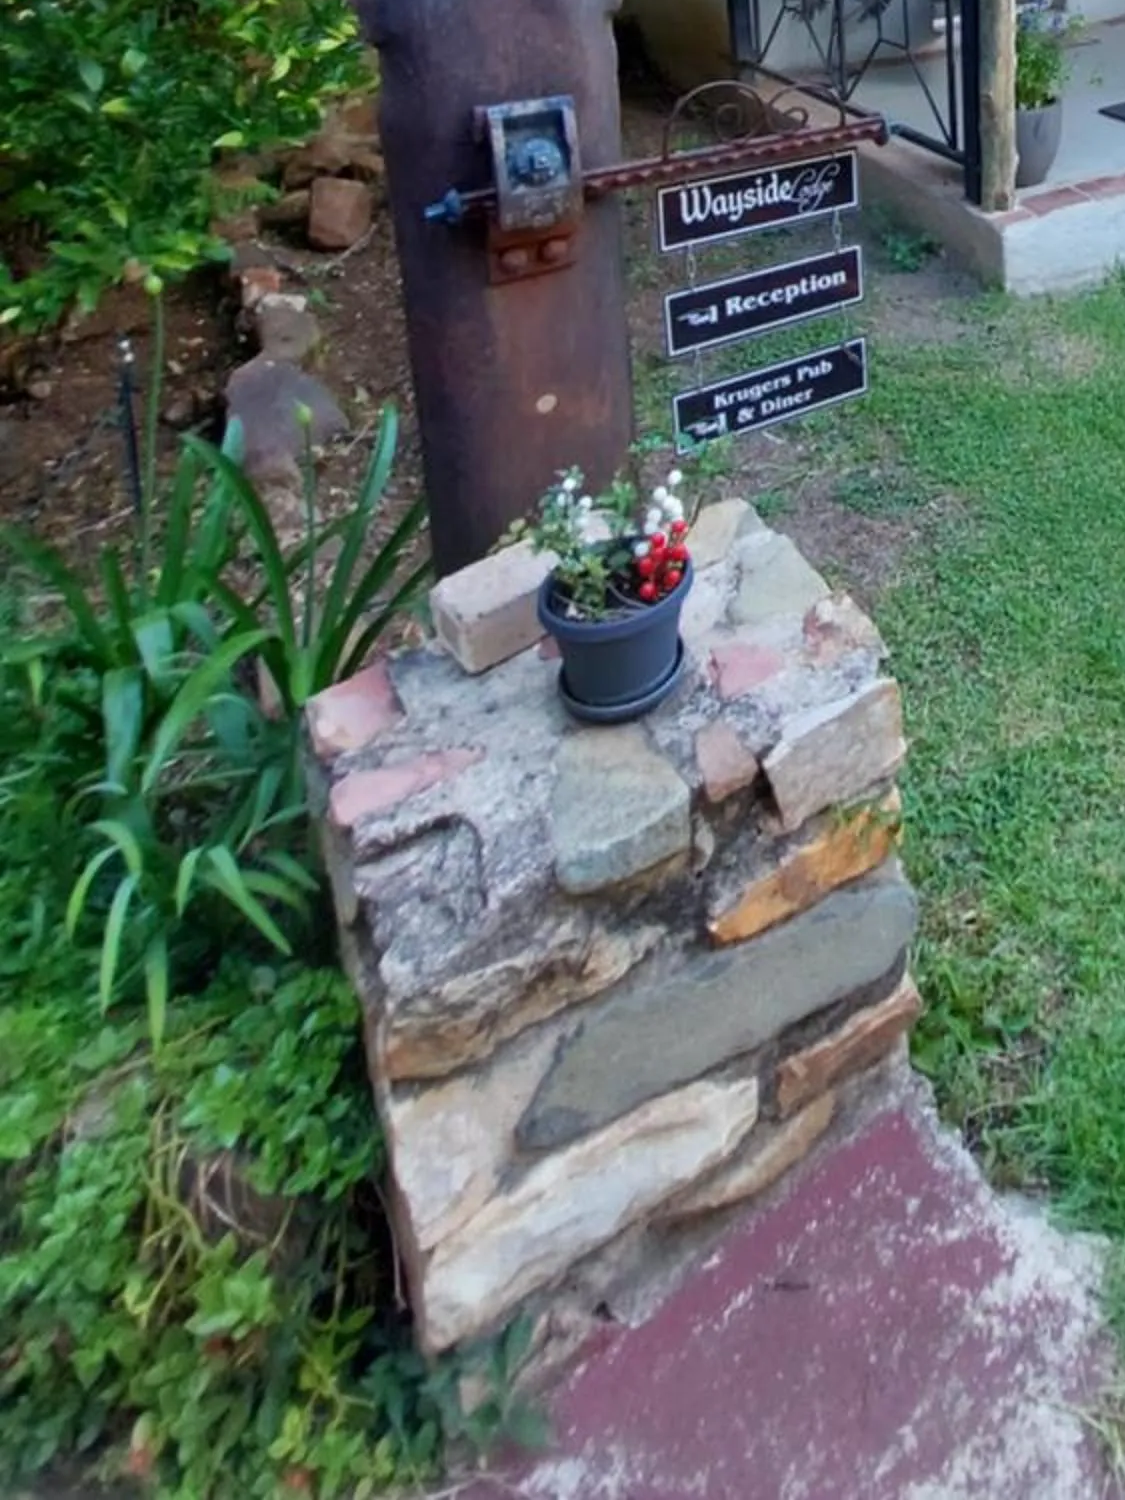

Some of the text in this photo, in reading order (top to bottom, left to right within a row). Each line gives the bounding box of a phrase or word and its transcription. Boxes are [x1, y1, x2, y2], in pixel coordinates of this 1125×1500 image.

[680, 172, 792, 224] Wayside
[726, 269, 847, 316] Reception
[713, 359, 833, 410] Krugers Pub
[736, 388, 814, 424] & Diner
